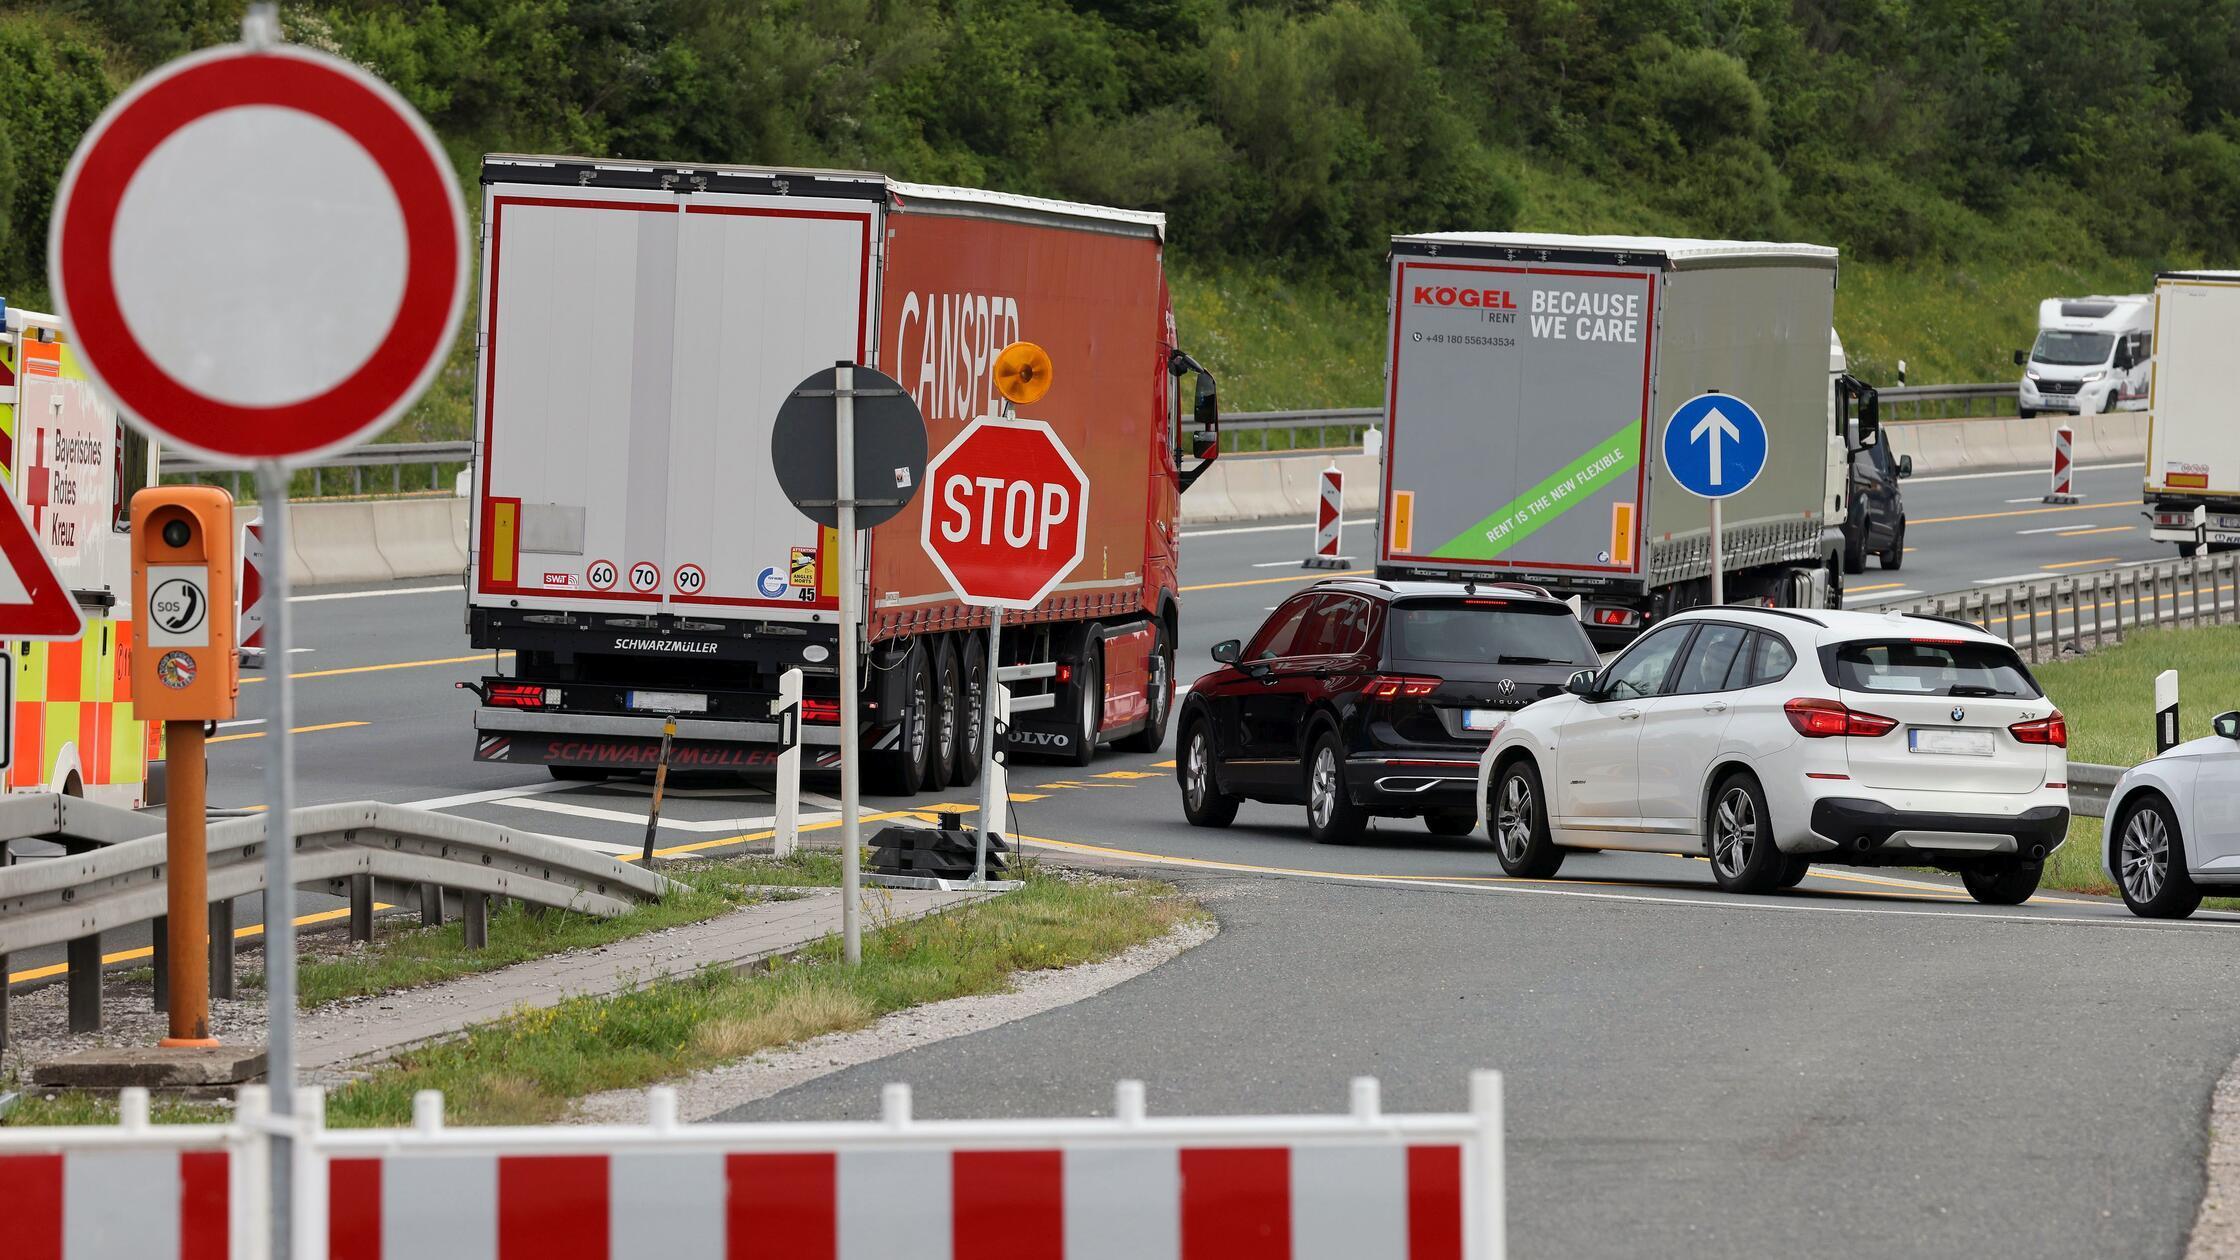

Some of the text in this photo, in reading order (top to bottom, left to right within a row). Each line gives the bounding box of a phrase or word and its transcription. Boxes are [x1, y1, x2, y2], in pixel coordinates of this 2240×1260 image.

[1413, 286, 1517, 309] KÖGEL
[1531, 290, 1639, 317] BECAUSE
[1489, 313, 1516, 324] RENT
[1530, 315, 1637, 343] WE CARE
[1426, 335, 1444, 343] +49
[1447, 335, 1462, 344] 180
[55, 429, 102, 470] Bayerisches
[53, 471, 76, 506] Rotes
[1486, 447, 1625, 543] RENT IS THE NEW FLEXIBLE
[941, 474, 1070, 550] STOP
[52, 512, 75, 547] Kreuz
[592, 567, 613, 584] 60
[635, 569, 654, 585] 70
[680, 572, 700, 588] 90
[799, 588, 815, 602] 45
[157, 602, 180, 612] SOS
[614, 638, 717, 654] SCHWARZMÜLLER
[2019, 711, 2036, 719] X1
[1007, 731, 1069, 747] OLVO
[543, 742, 778, 765] SCHWARMÜLLER
